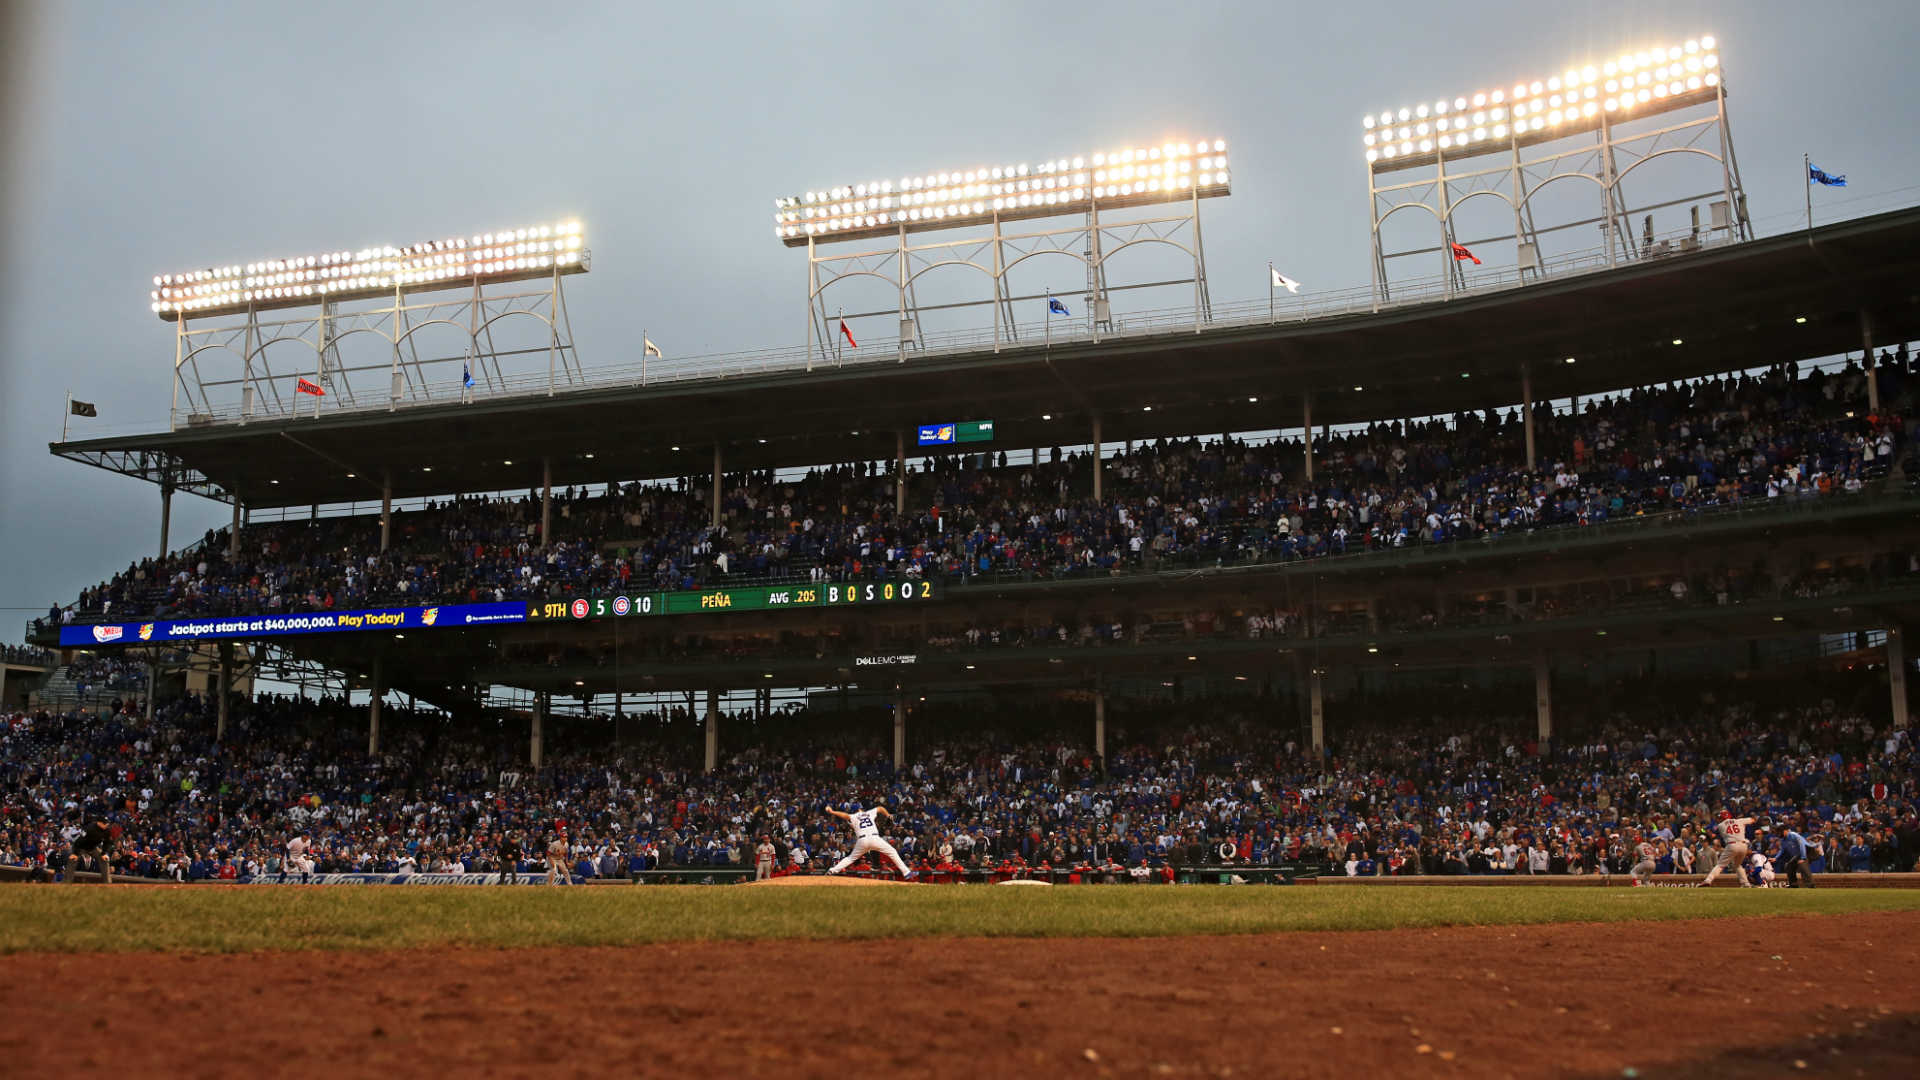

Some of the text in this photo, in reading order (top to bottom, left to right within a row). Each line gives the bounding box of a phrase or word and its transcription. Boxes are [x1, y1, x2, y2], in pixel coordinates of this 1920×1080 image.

[702, 592, 731, 608] PEÑA
[769, 590, 816, 604] AVG .205
[829, 587, 839, 602] B
[847, 586, 856, 601] 0
[865, 584, 874, 600] S
[884, 583, 893, 599] 0
[921, 582, 931, 598] 2
[545, 603, 566, 618] 9TH
[597, 600, 605, 615] 5
[635, 597, 650, 613] 10
[169, 612, 405, 636] Jackpot starts at $40,000,000. Play Today!
[859, 817, 873, 829] 29
[1726, 824, 1740, 834] 46
